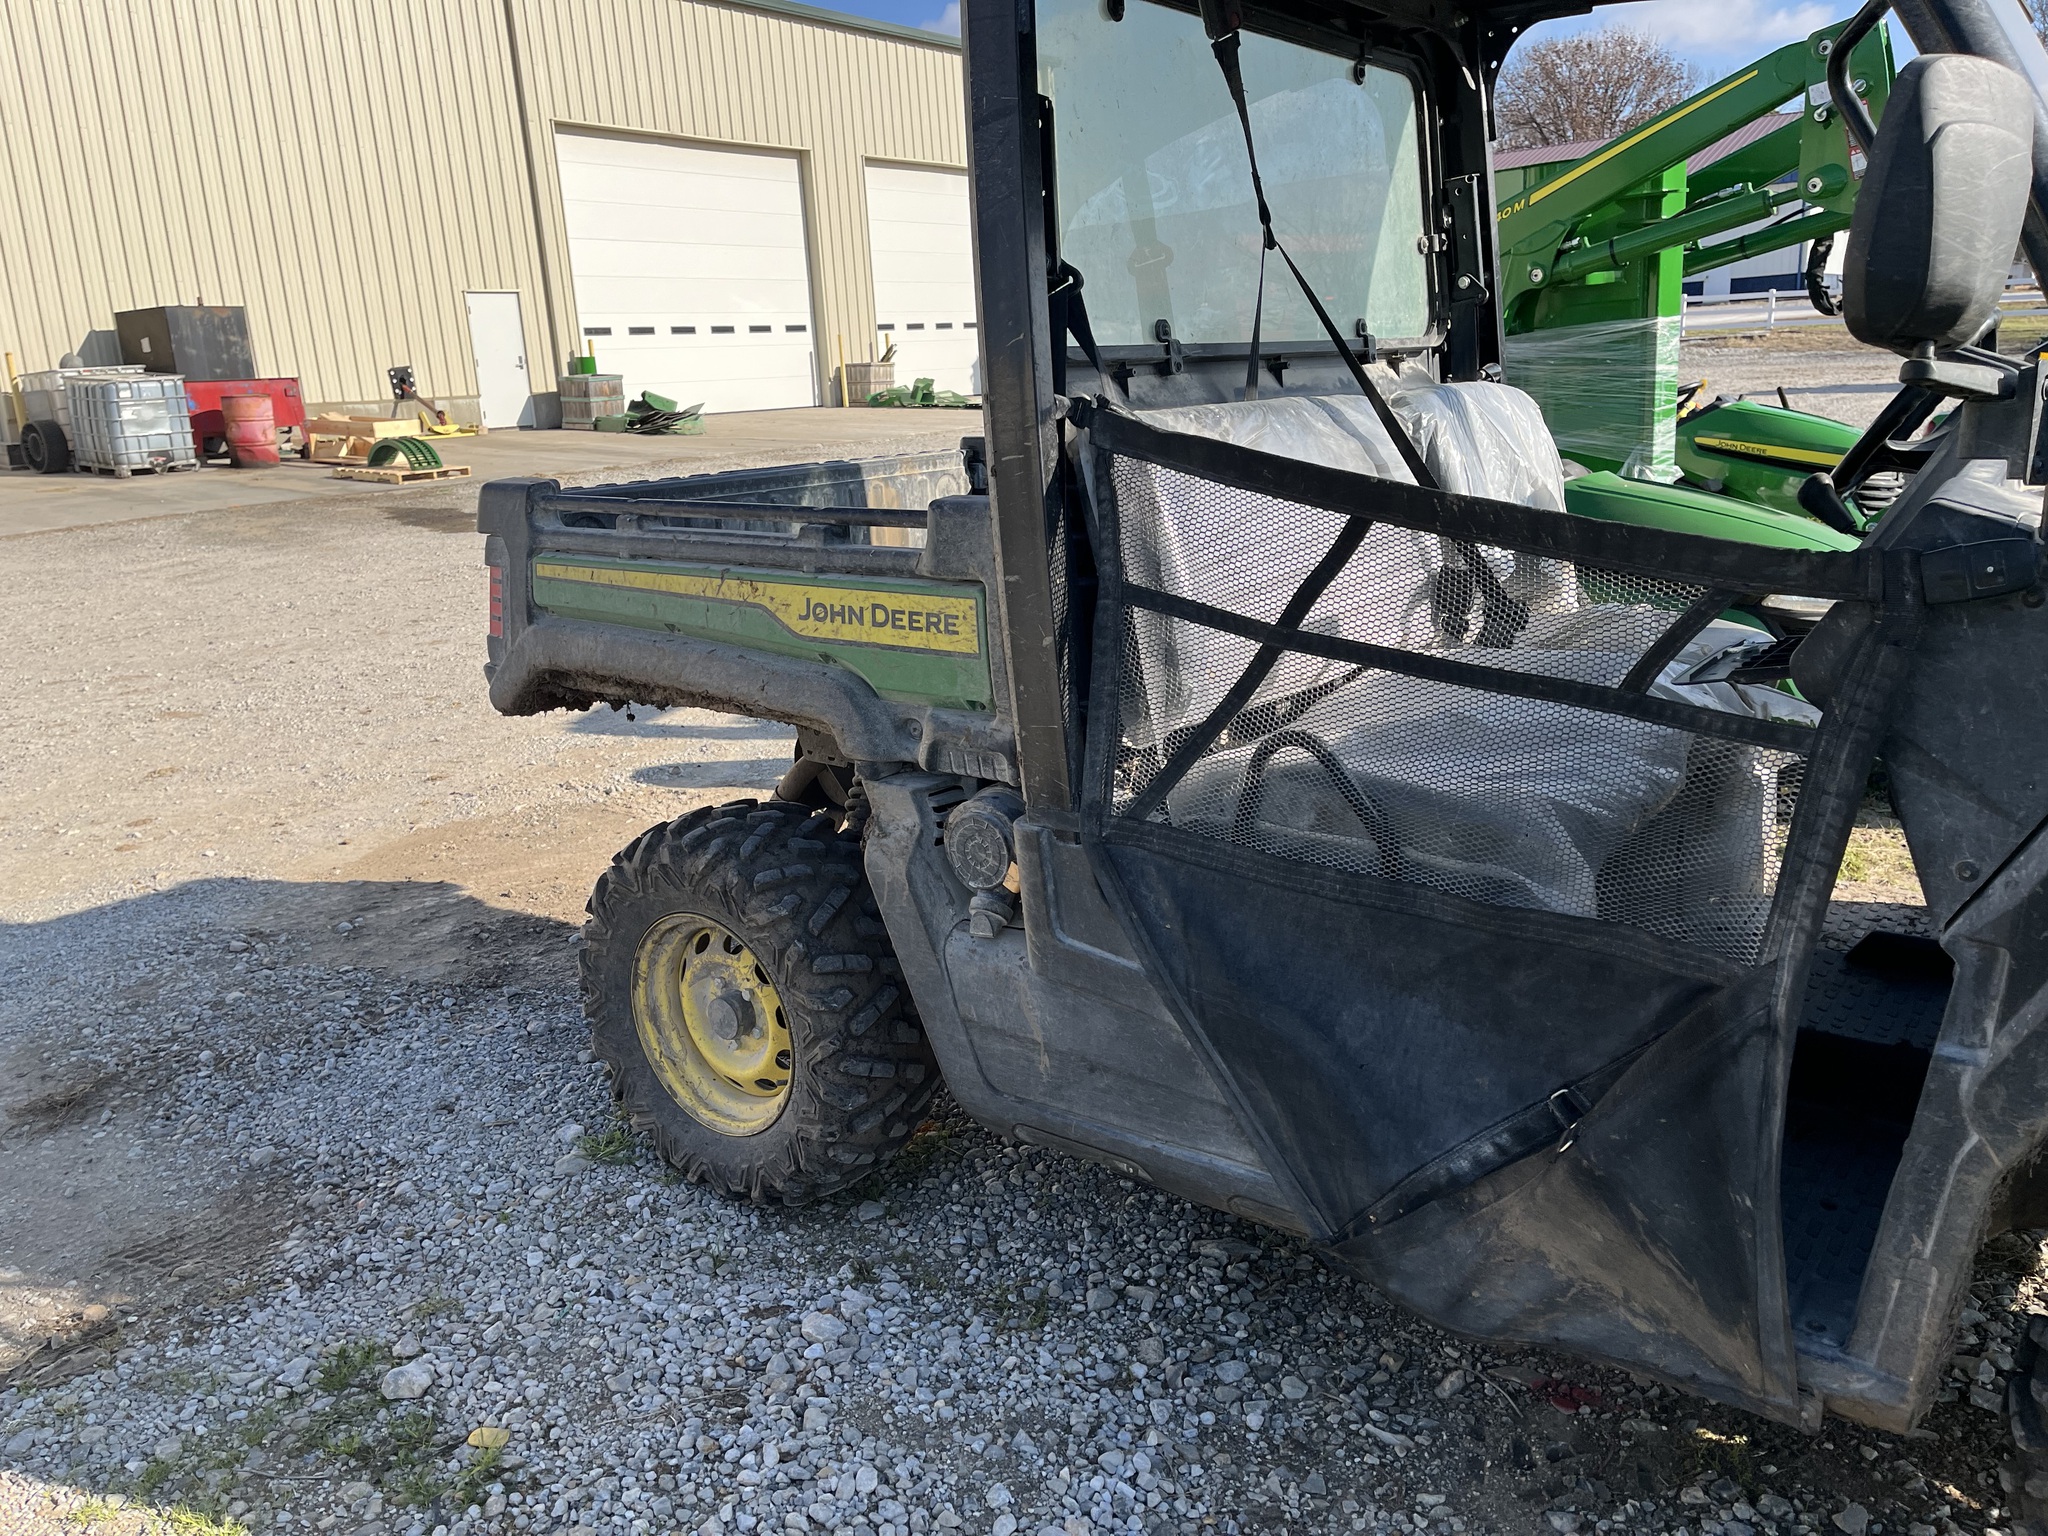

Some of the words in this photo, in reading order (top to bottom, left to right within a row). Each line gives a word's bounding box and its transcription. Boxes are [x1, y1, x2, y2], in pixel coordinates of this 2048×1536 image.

[1717, 441, 1738, 450] JOHN
[1740, 444, 1767, 455] DEERE
[798, 597, 864, 627] JOHN
[871, 603, 960, 636] DEERE
